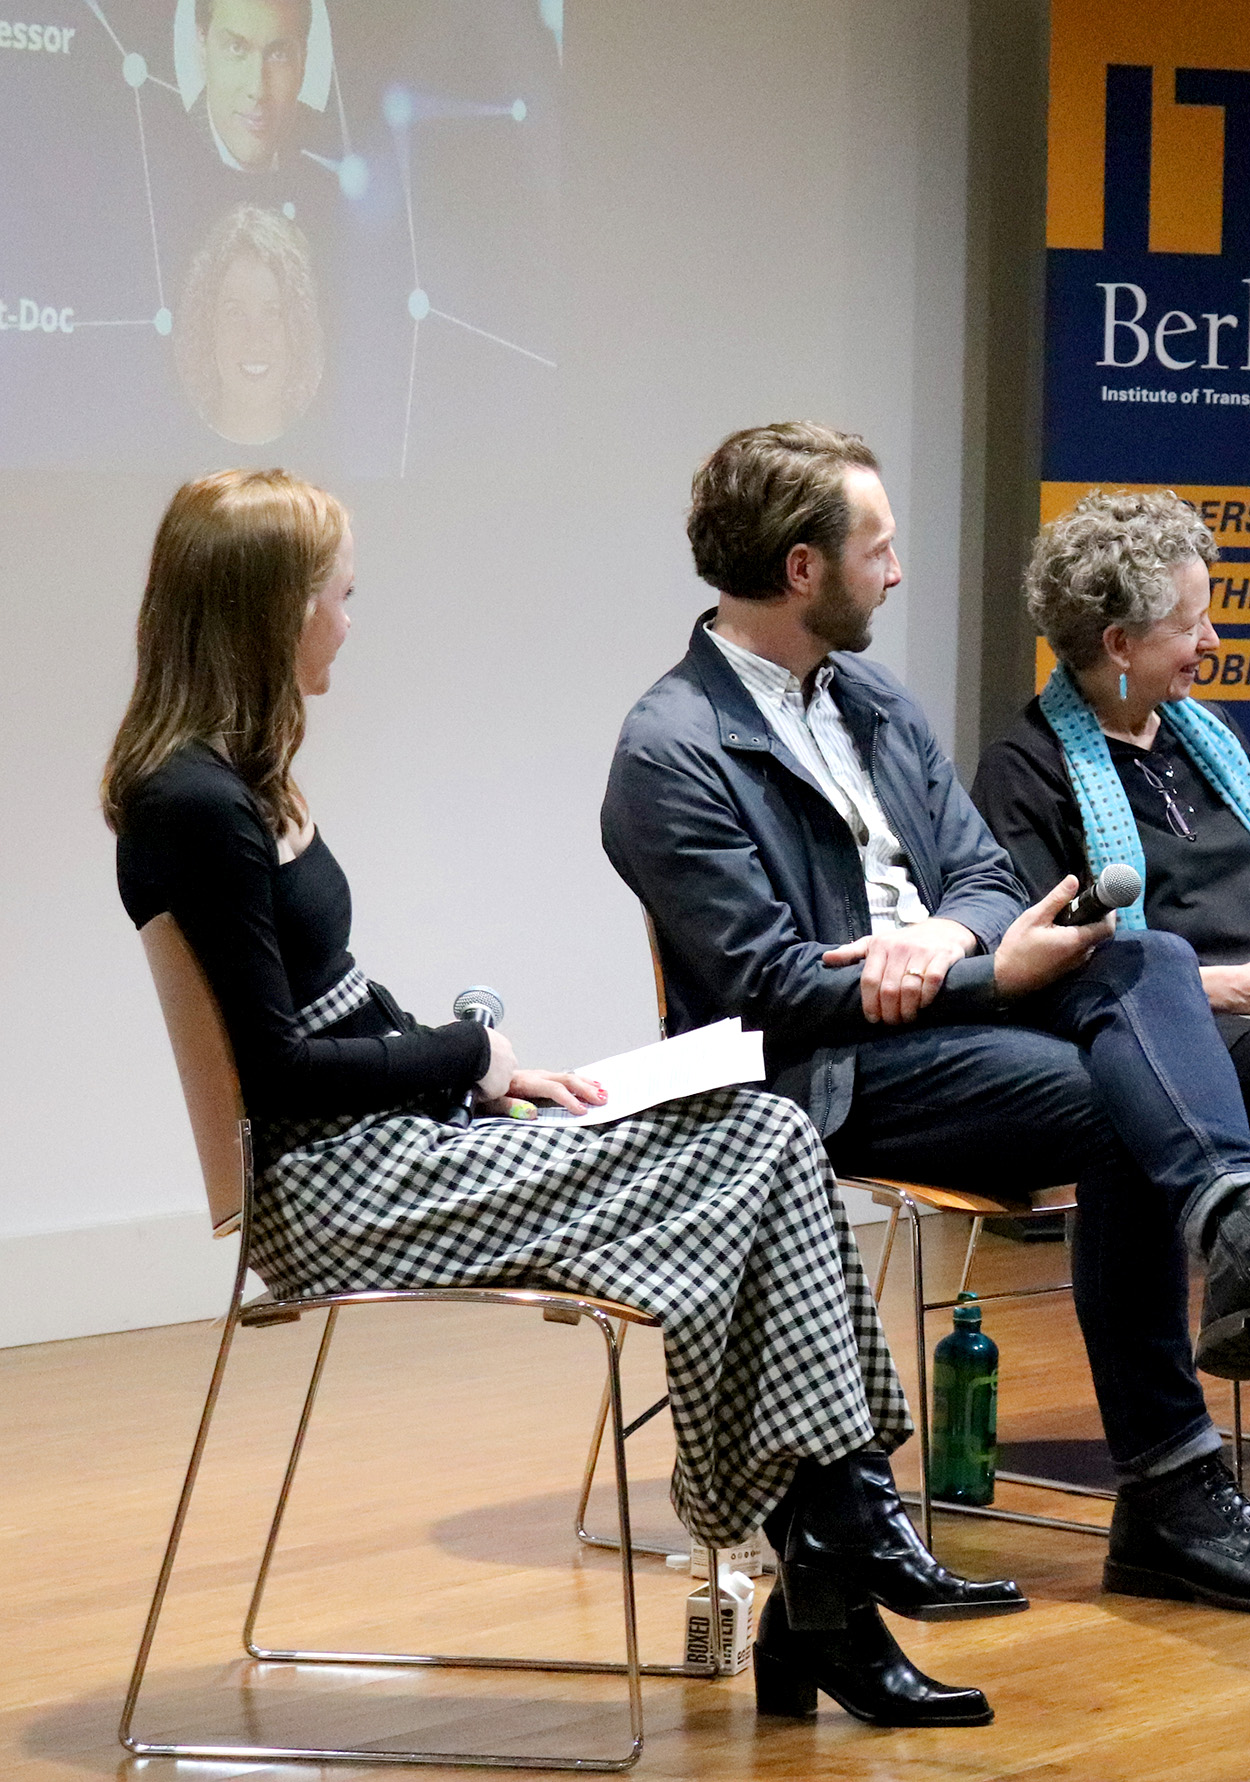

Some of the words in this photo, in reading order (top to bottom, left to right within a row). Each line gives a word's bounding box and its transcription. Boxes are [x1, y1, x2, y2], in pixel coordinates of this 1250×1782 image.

[1101, 386, 1177, 403] Institute
[1180, 389, 1199, 403] of
[687, 1615, 710, 1664] BOXED
